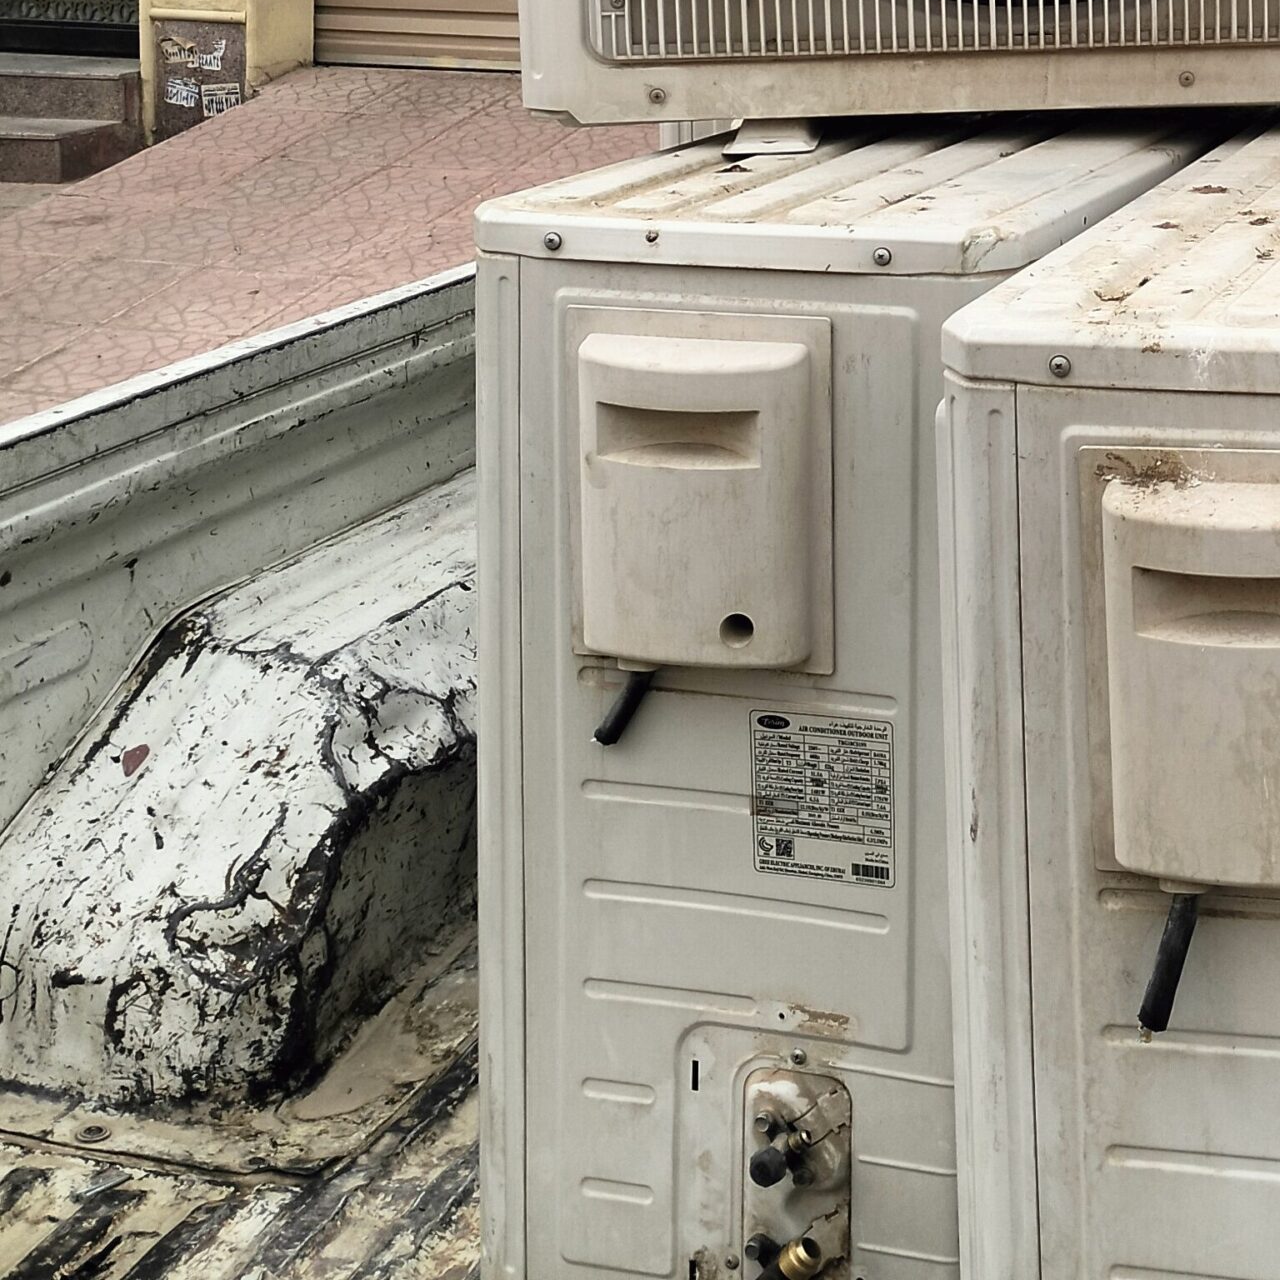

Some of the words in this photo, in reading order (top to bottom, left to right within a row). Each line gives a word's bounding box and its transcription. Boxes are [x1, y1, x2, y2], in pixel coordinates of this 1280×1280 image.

[809, 726, 846, 735] CONDITIONER
[847, 730, 873, 738] OUTDOOR
[874, 732, 888, 740] UNIT
